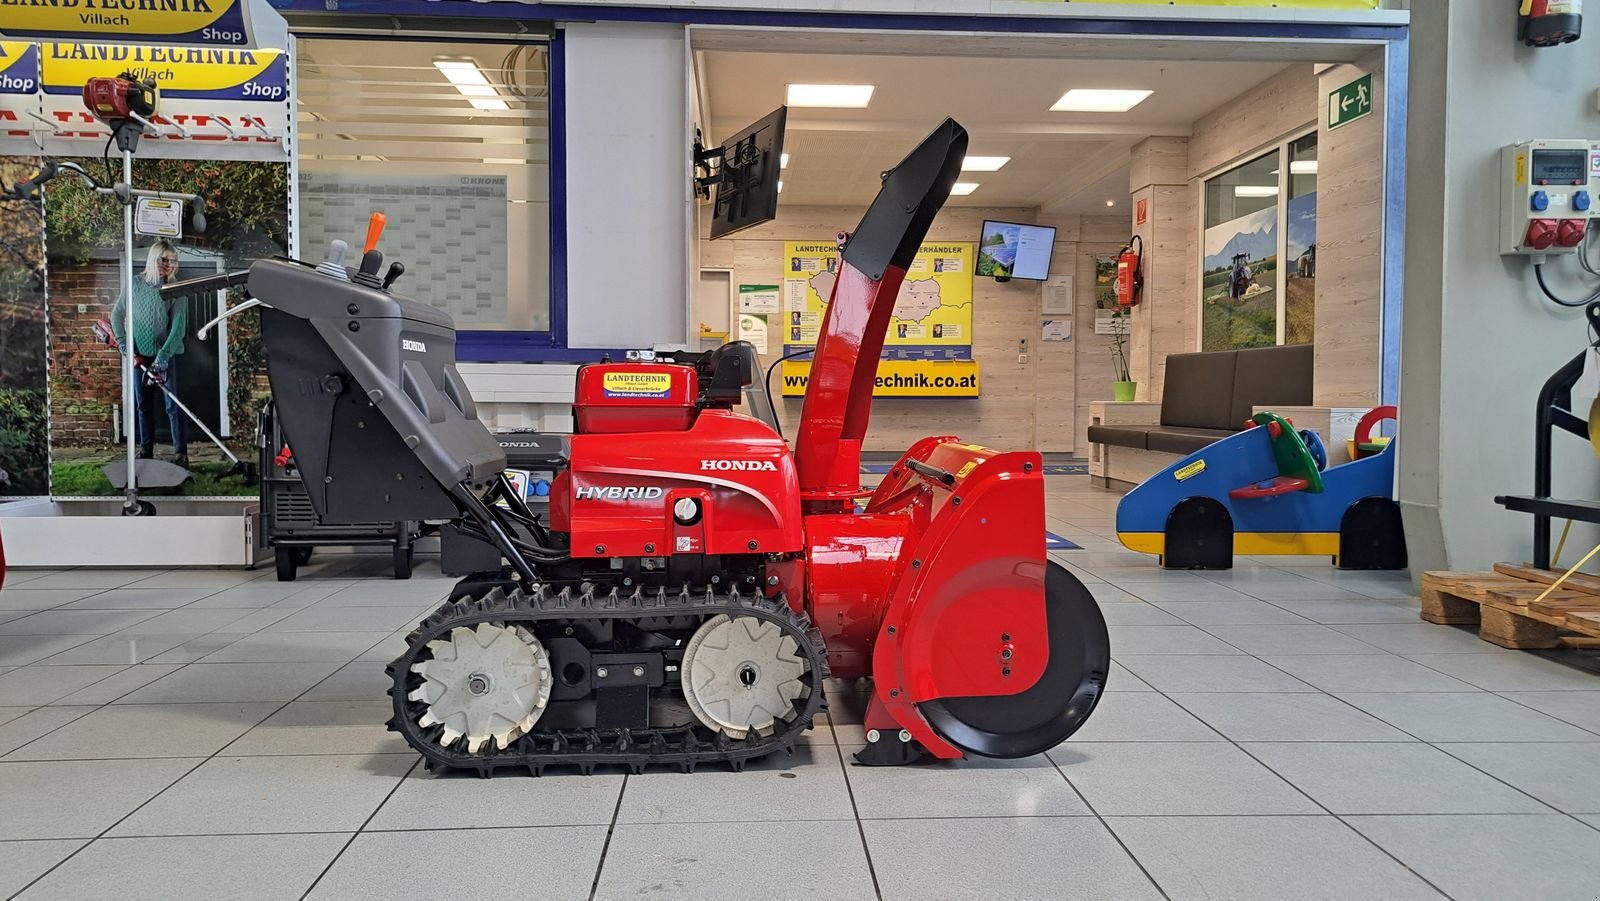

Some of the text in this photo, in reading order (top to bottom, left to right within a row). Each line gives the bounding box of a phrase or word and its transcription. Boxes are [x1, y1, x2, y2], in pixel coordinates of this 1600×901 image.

[80, 13, 130, 26] Villach
[202, 27, 242, 42] Shop
[242, 82, 282, 98] Shop
[470, 177, 505, 185] KRONE
[402, 339, 427, 353] HONDA
[700, 460, 778, 471] HONDA
[575, 486, 663, 499] HYBRID
